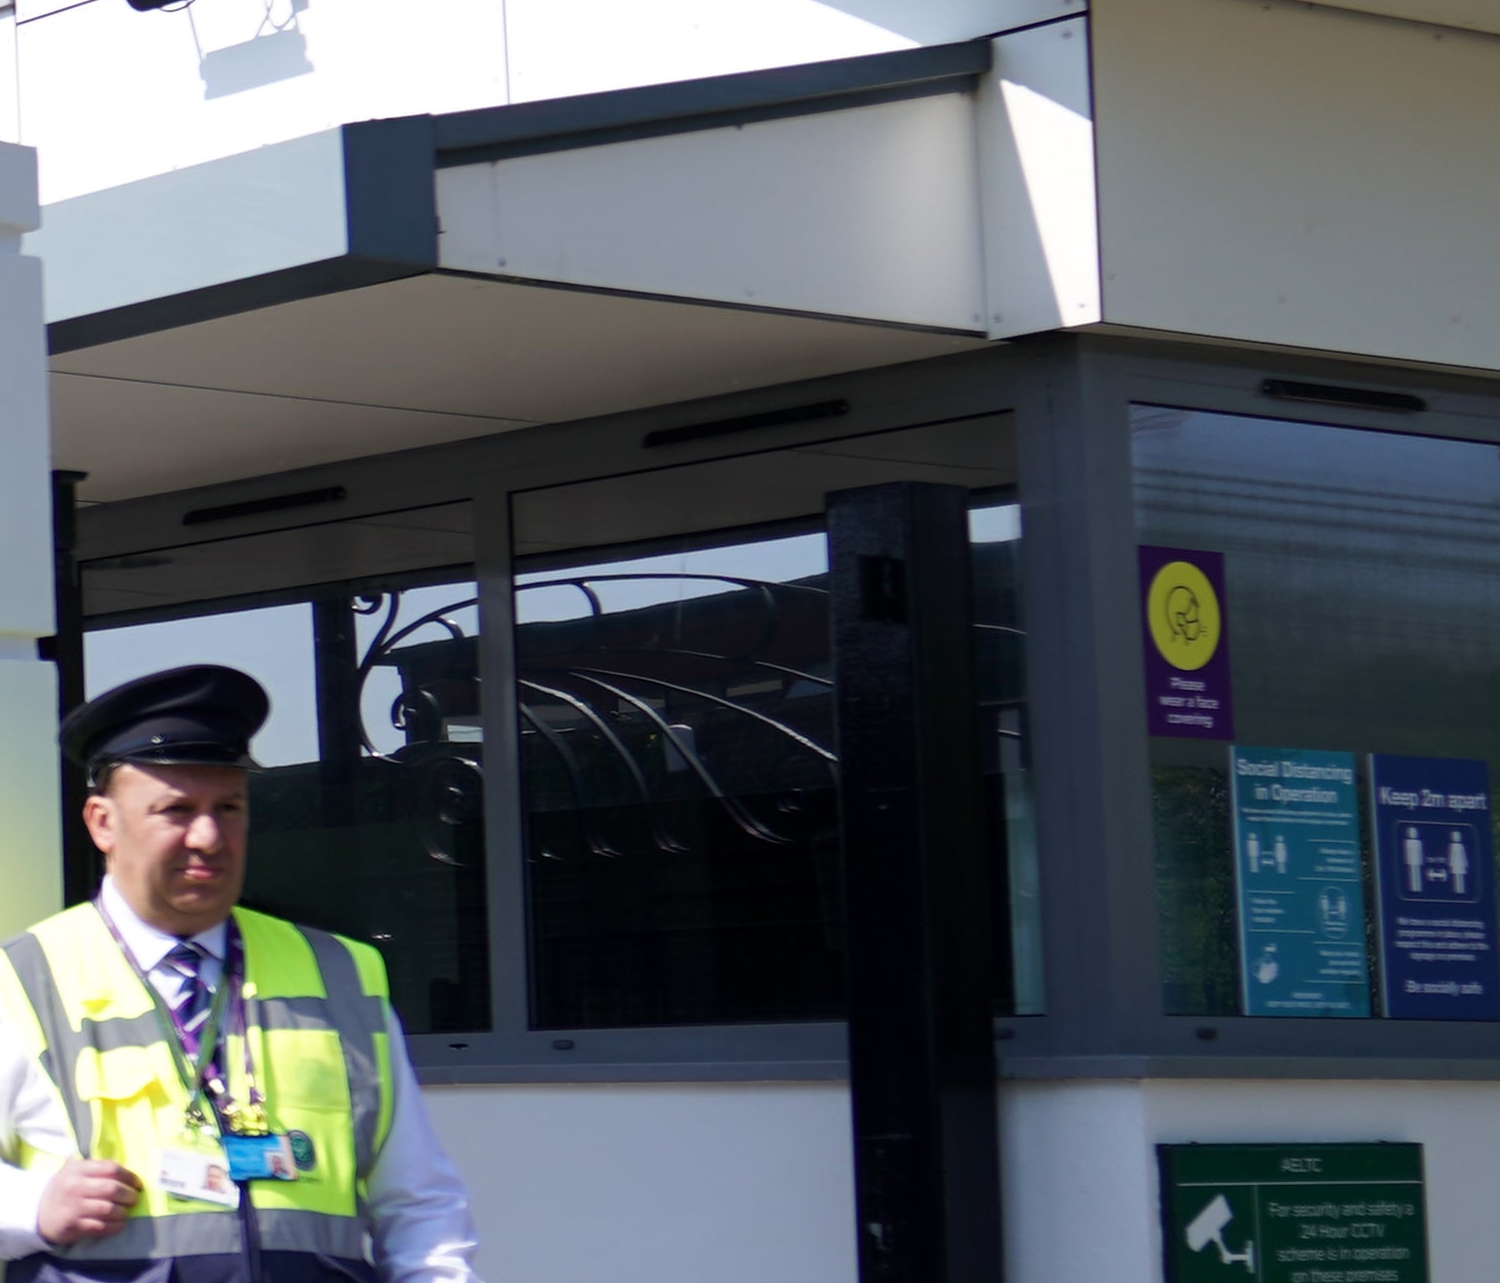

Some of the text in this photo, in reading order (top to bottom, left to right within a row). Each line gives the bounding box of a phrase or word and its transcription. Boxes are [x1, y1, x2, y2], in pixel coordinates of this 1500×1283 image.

[1237, 759, 1352, 784] Social Distancing
[1255, 783, 1338, 804] in Operation
[1379, 786, 1488, 813] Keep 2m apart
[1280, 1158, 1322, 1173] AELTC
[1269, 1202, 1415, 1219] For security and safety a
[1300, 1223, 1385, 1239] 24 Hour CCTV
[1277, 1246, 1410, 1263] scheme is in operation
[1291, 1270, 1308, 1283] on
[1311, 1269, 1344, 1283] these
